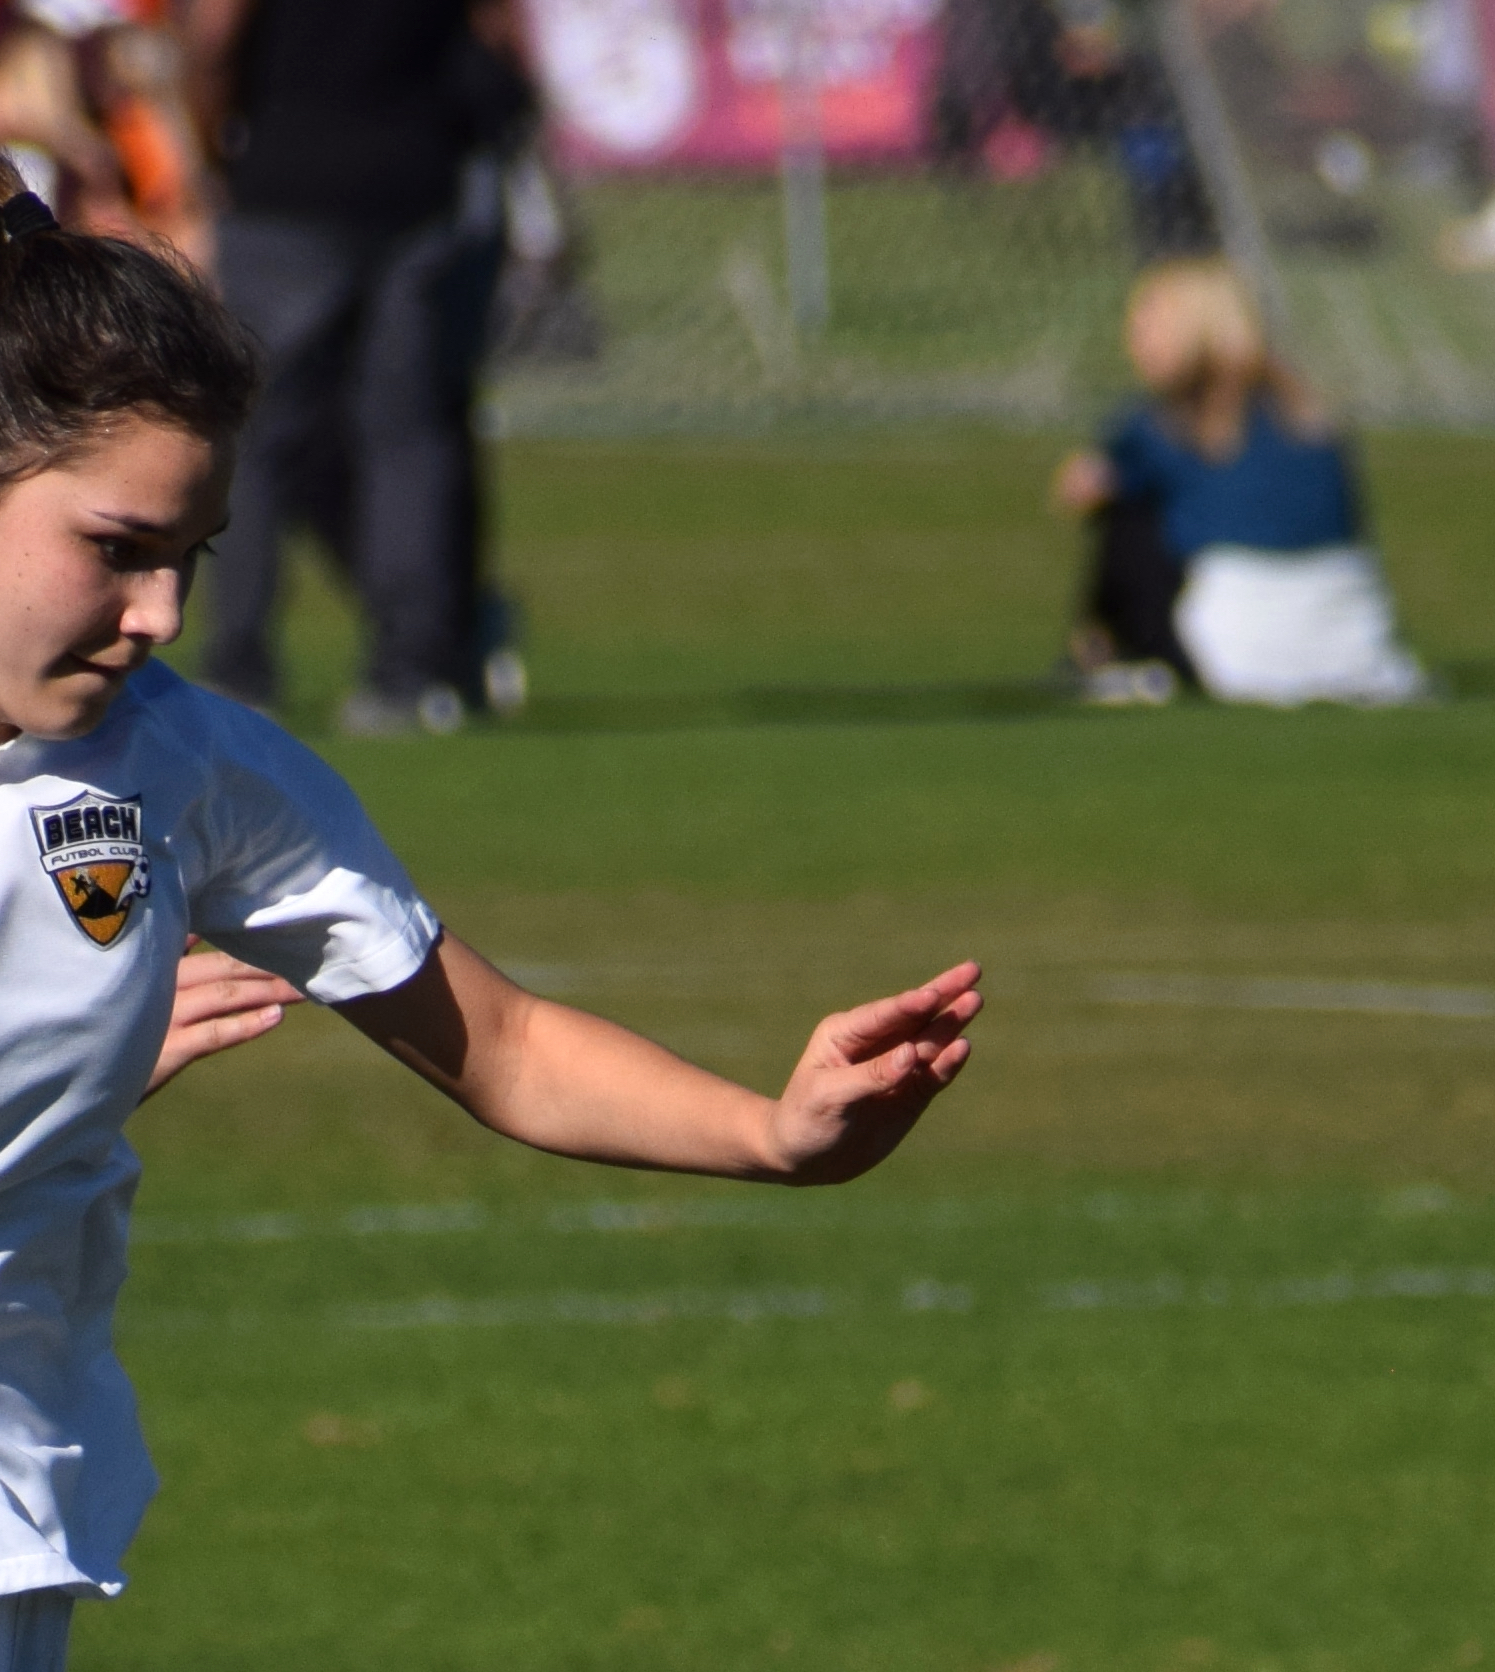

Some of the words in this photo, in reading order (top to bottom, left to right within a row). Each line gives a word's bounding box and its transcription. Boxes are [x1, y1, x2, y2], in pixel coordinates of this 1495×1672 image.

[43, 805, 137, 850] BEACH
[51, 848, 104, 865] FUTBOL
[109, 846, 139, 856] CLUB
